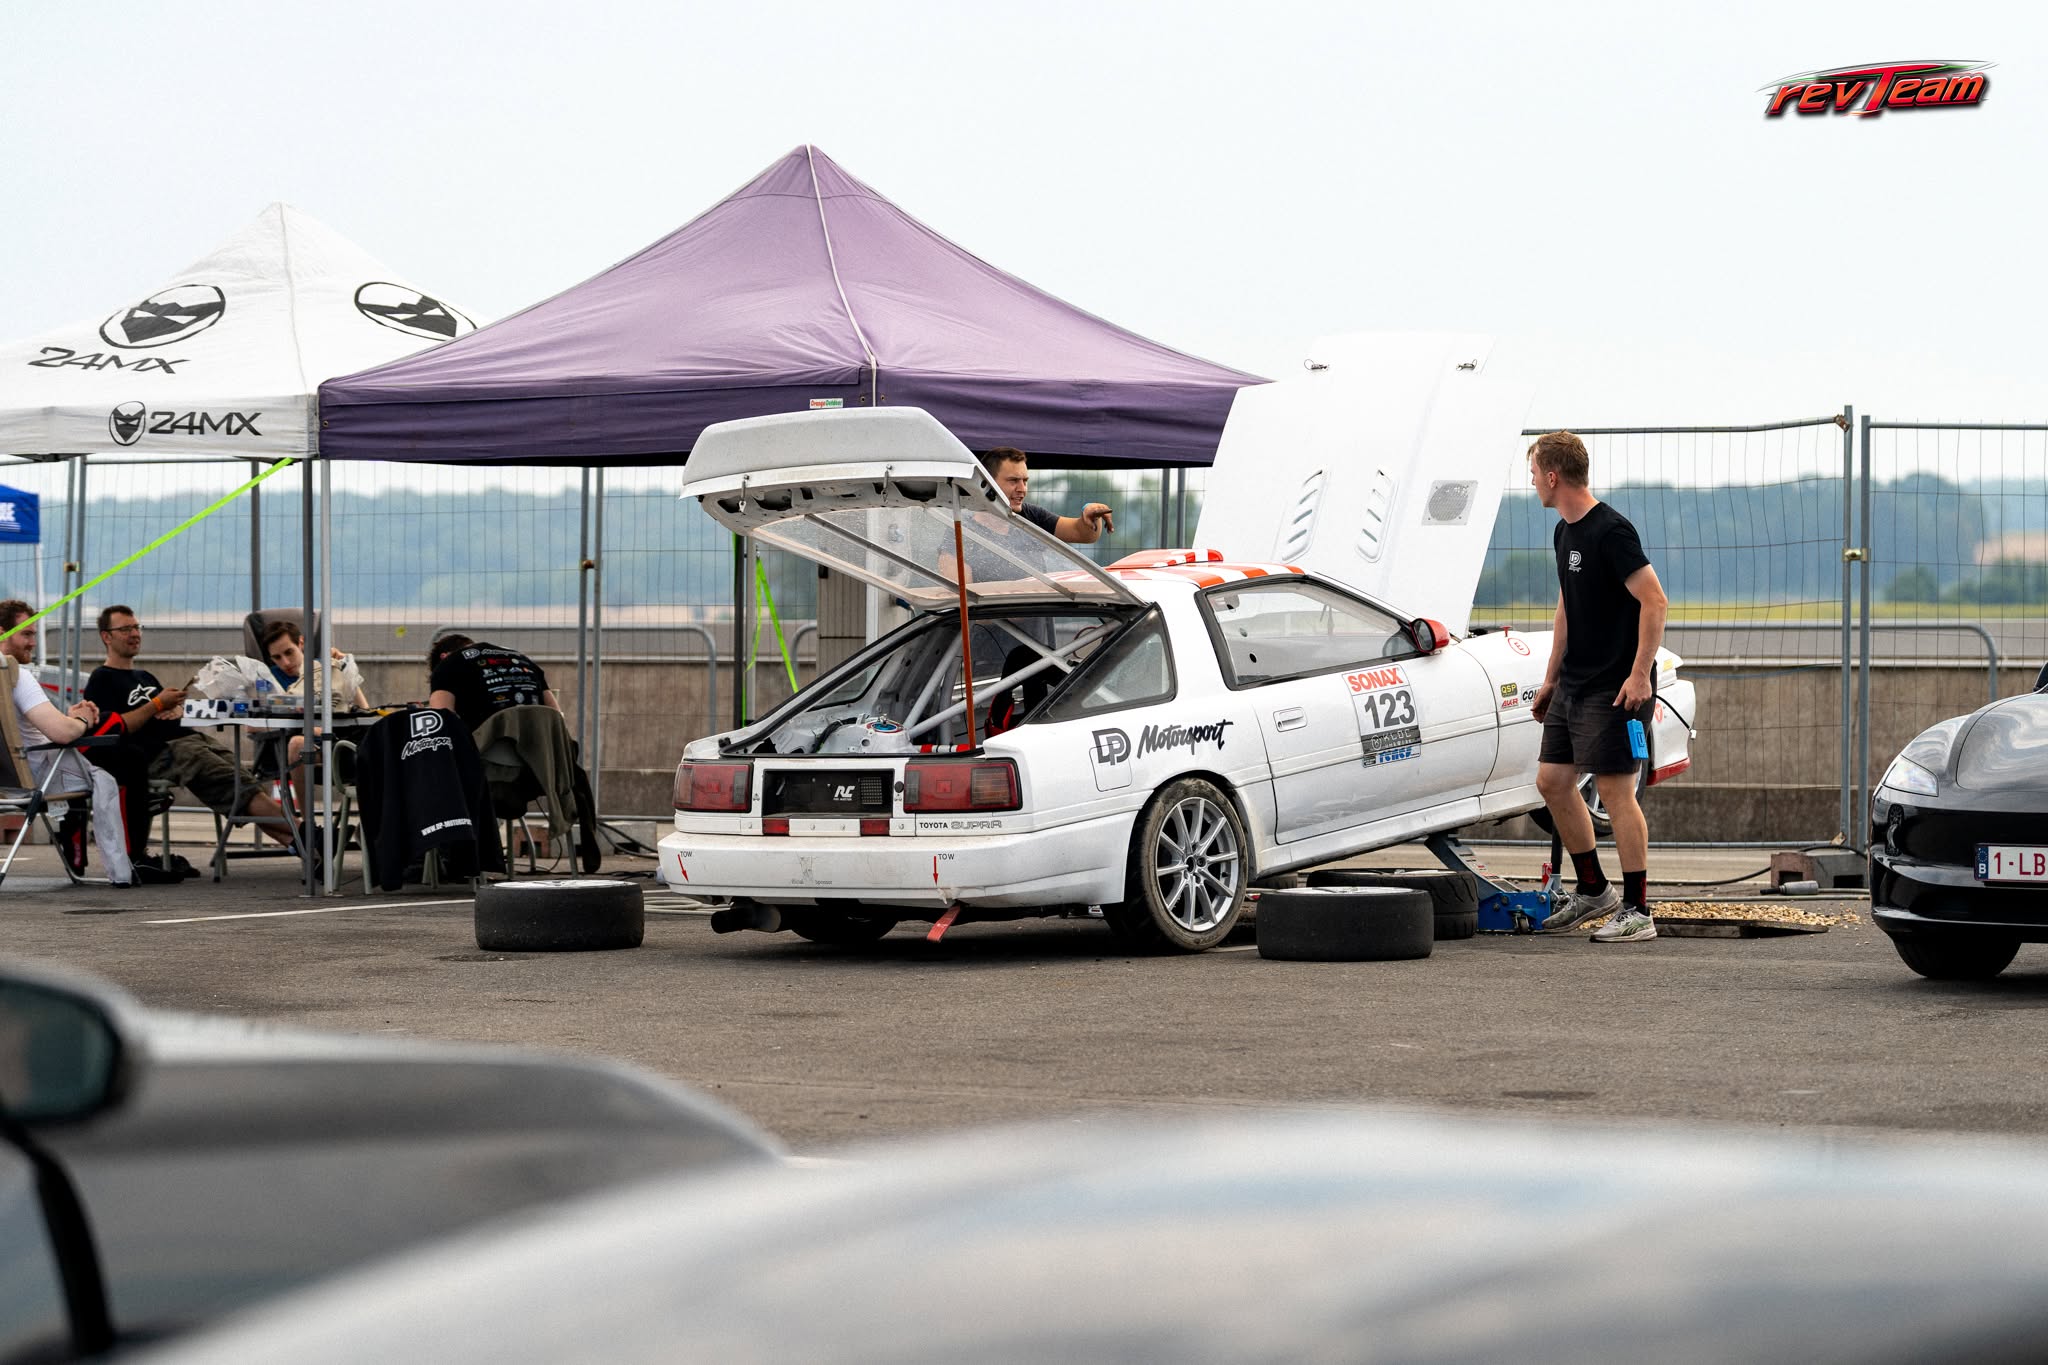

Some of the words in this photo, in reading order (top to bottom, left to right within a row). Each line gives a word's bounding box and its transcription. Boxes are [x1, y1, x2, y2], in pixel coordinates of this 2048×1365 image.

[27, 346, 191, 374] 24MX
[149, 411, 262, 436] 24MX
[1347, 667, 1403, 692] SONAX
[1364, 690, 1415, 729] 123
[1136, 719, 1234, 759] Motorsport
[951, 820, 1002, 829] SUPRA
[1979, 863, 1987, 874] B
